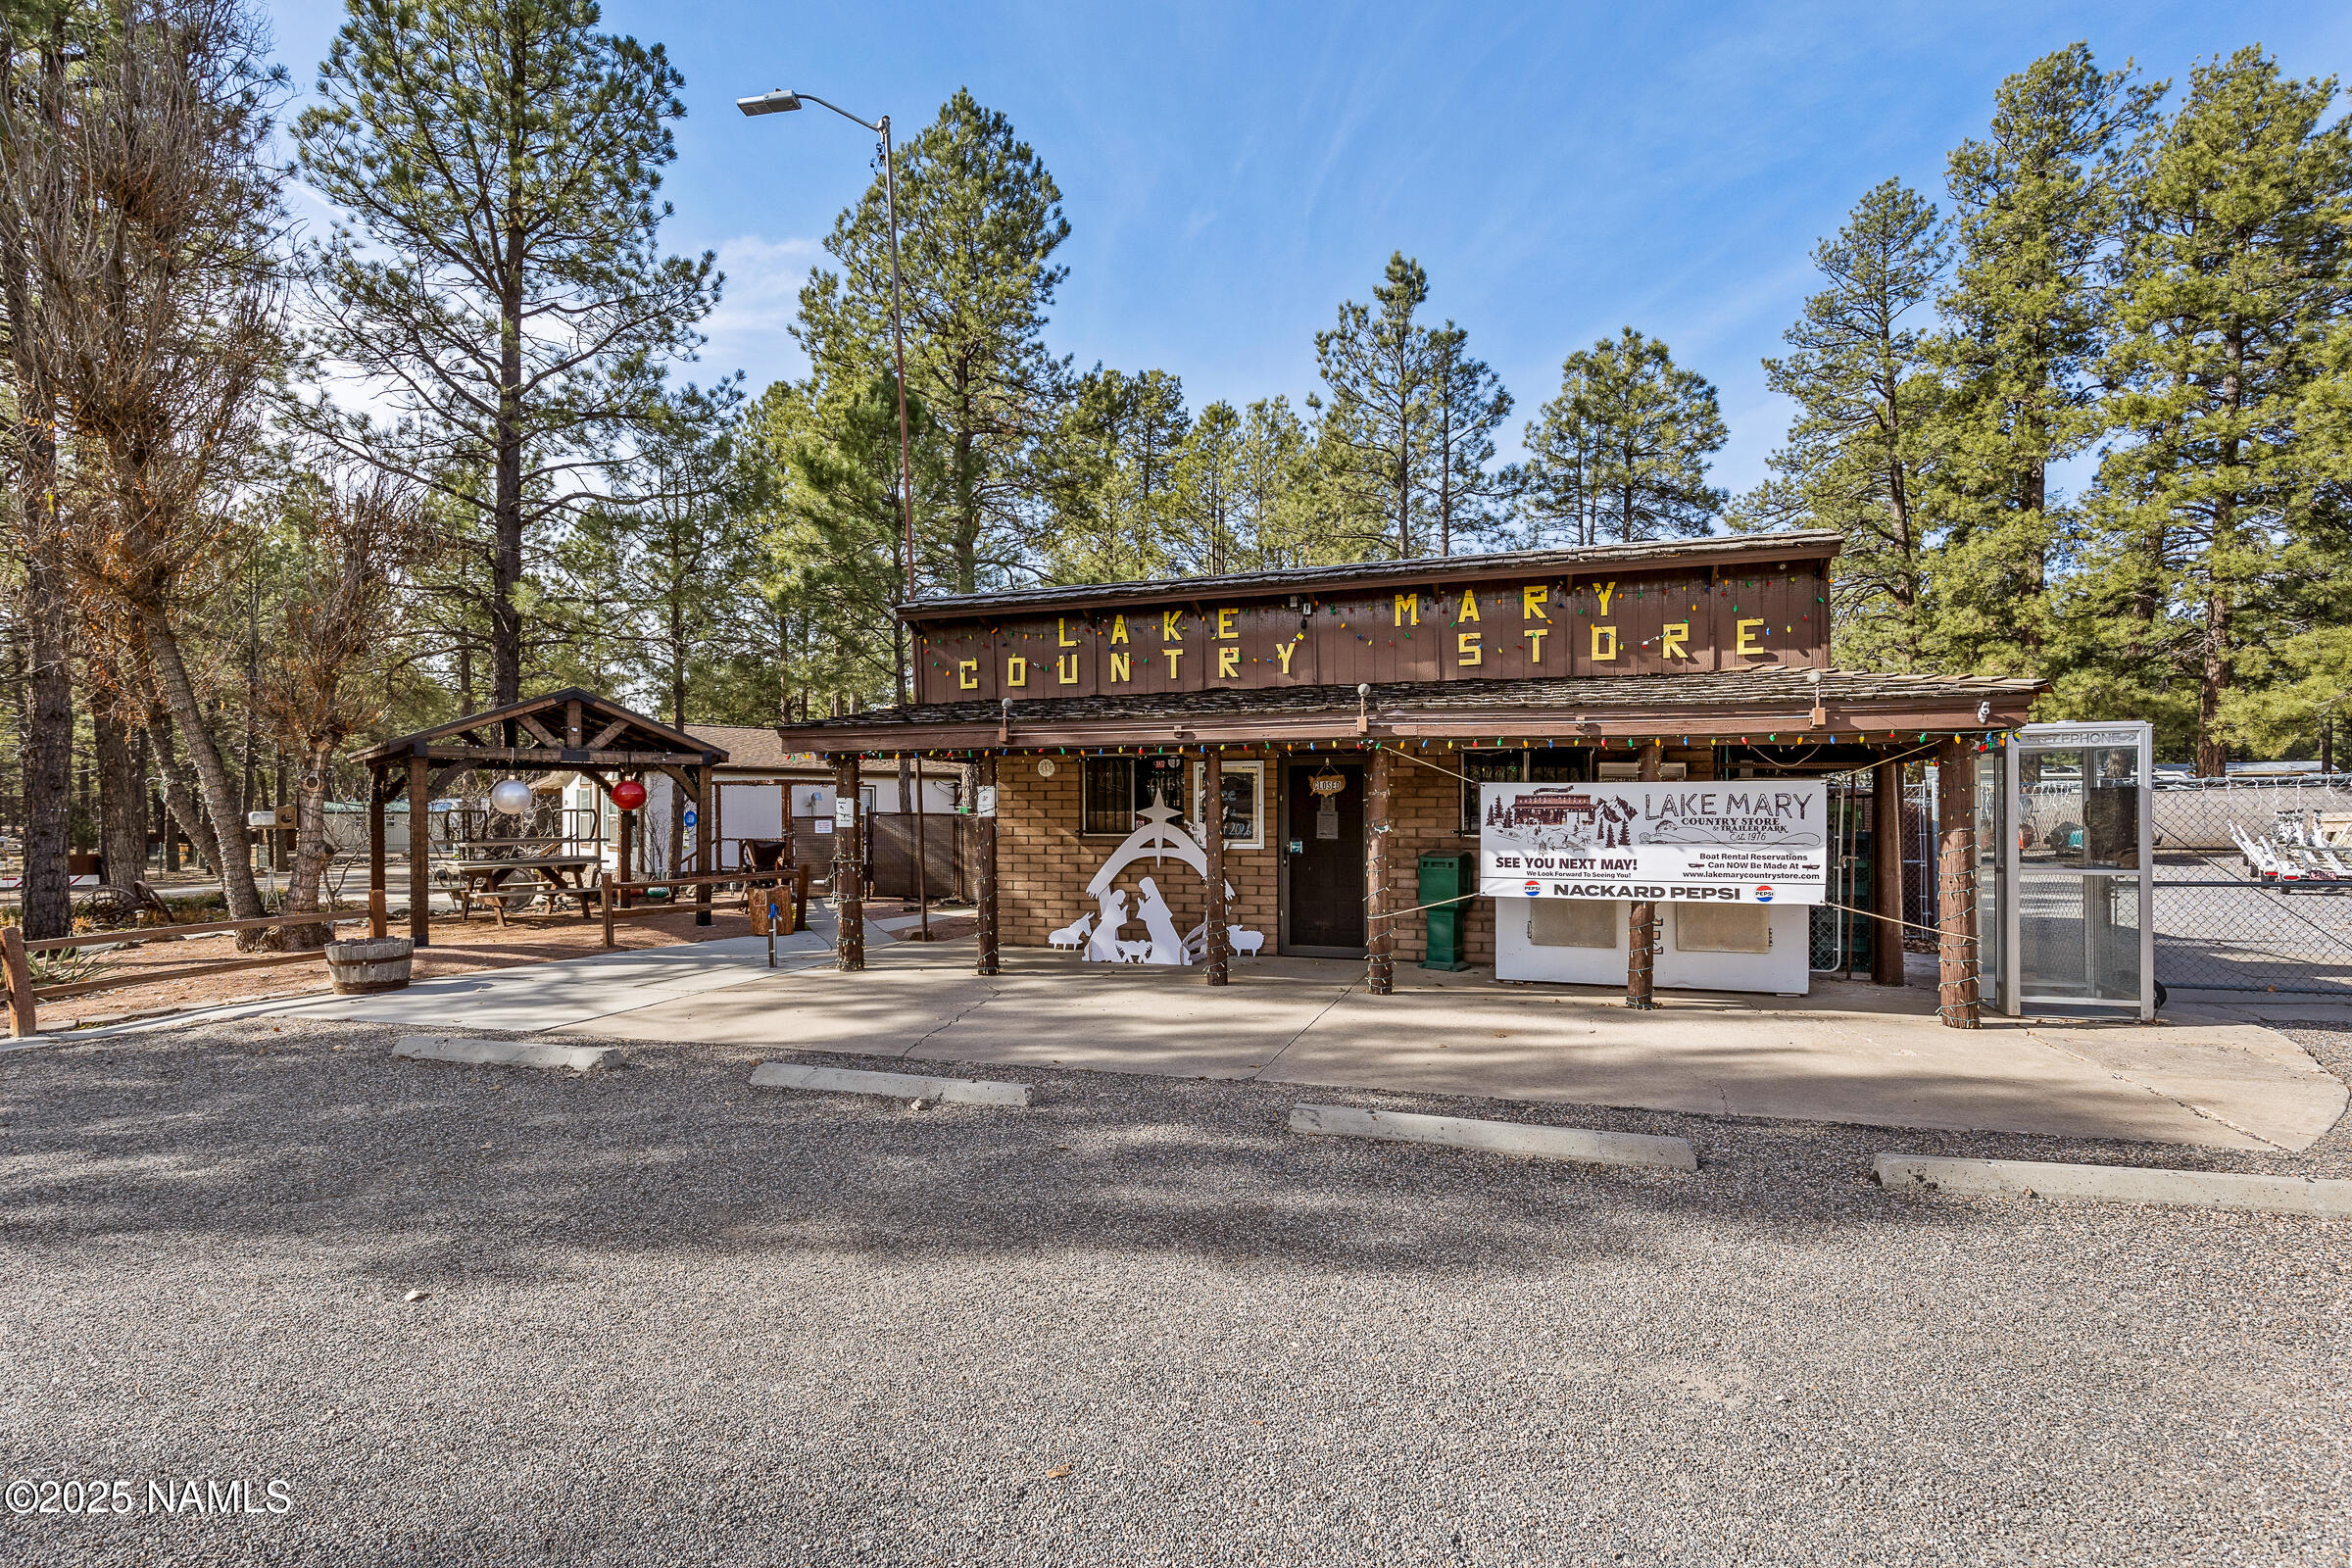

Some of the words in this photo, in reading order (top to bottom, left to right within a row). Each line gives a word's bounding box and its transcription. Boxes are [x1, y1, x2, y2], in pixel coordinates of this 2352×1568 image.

[1058, 608, 1240, 648] LAKE
[1395, 581, 1616, 627] MARY
[959, 643, 1298, 690] COUNTRY
[1457, 618, 1765, 666] STORE
[1313, 781, 1342, 790] CLOSED
[1644, 793, 1717, 821] LAKE
[1726, 793, 1813, 820] MARY
[1681, 817, 1739, 826] COUNTRY
[1740, 817, 1780, 826] STORE
[1747, 832, 1767, 841] 1976
[1495, 857, 1521, 868] SEE
[1525, 858, 1555, 869] YOU
[1559, 858, 1596, 870] NEXT
[1600, 858, 1638, 871] MAY!
[1682, 870, 1820, 881] www.lakemarycountrystore.com
[1553, 884, 1666, 899] NACKARD
[1670, 887, 1740, 901] PEPSI
